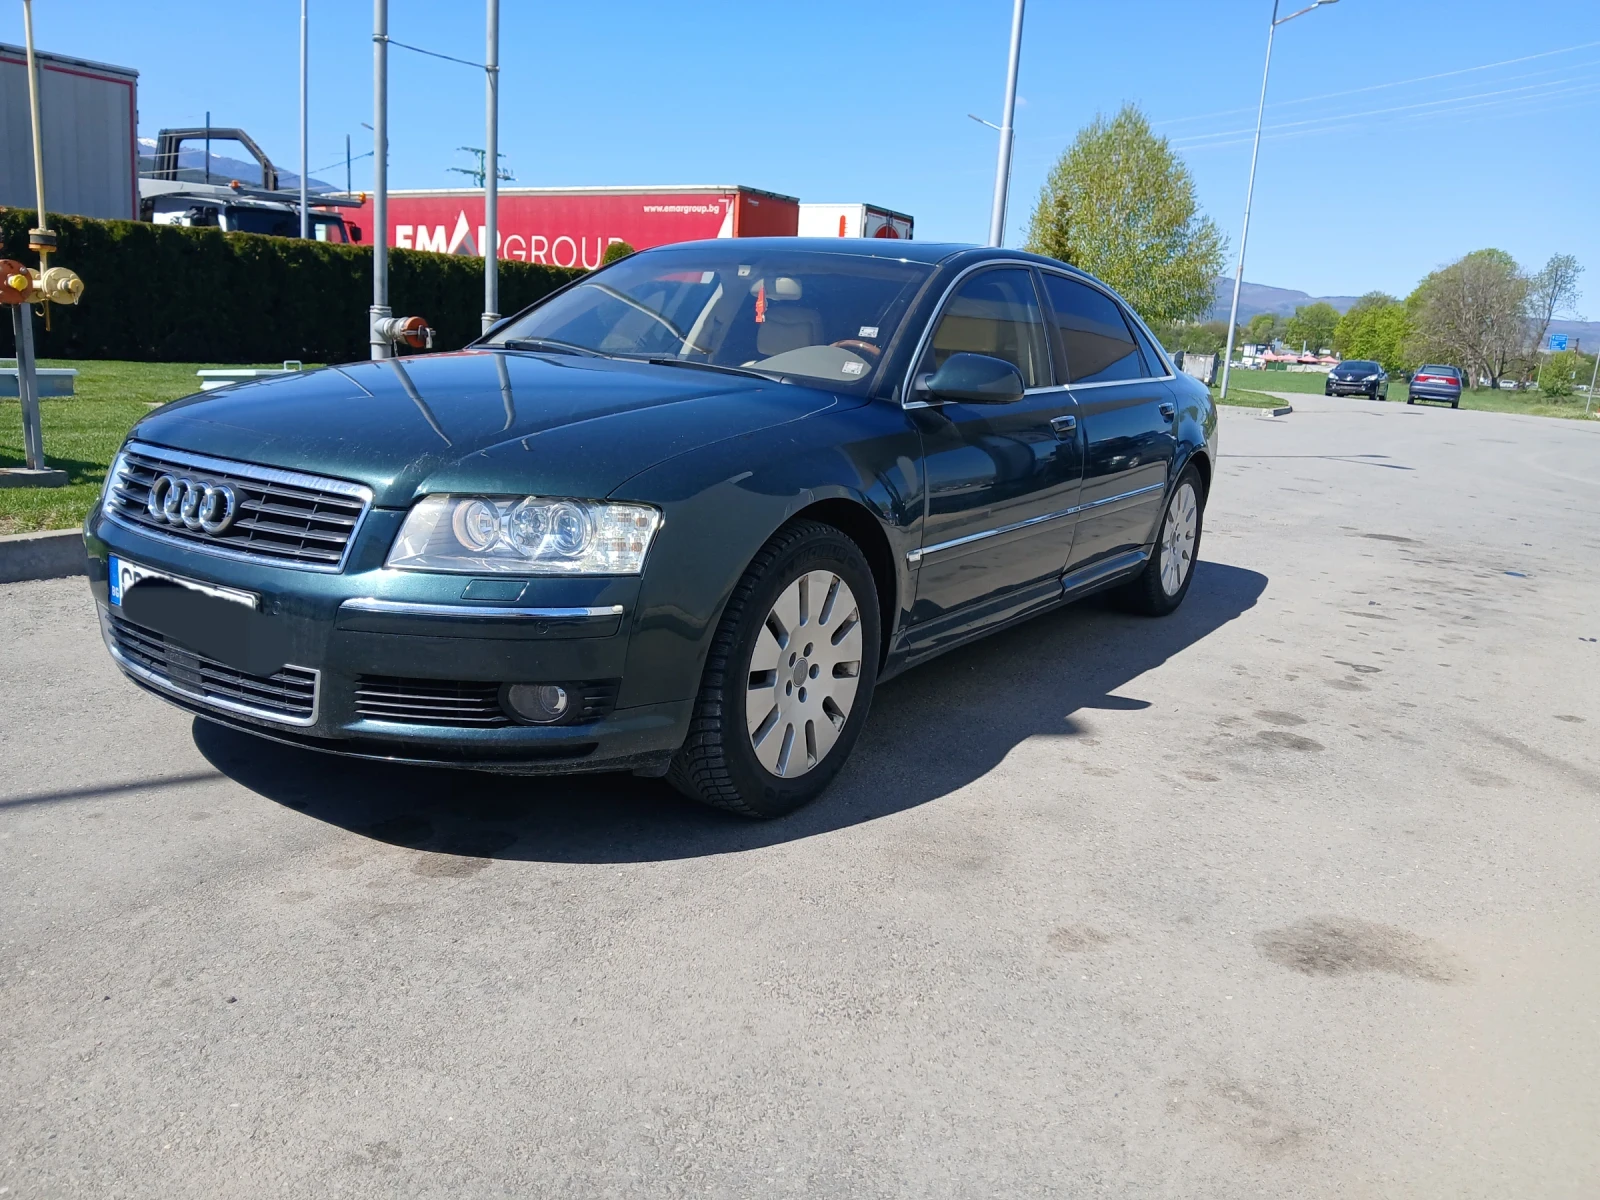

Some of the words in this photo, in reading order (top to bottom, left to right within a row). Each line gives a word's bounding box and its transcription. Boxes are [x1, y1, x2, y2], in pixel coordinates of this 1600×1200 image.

[643, 204, 720, 214] www.emargroup.bg
[503, 234, 624, 271] GROU
[111, 585, 120, 598] BG
